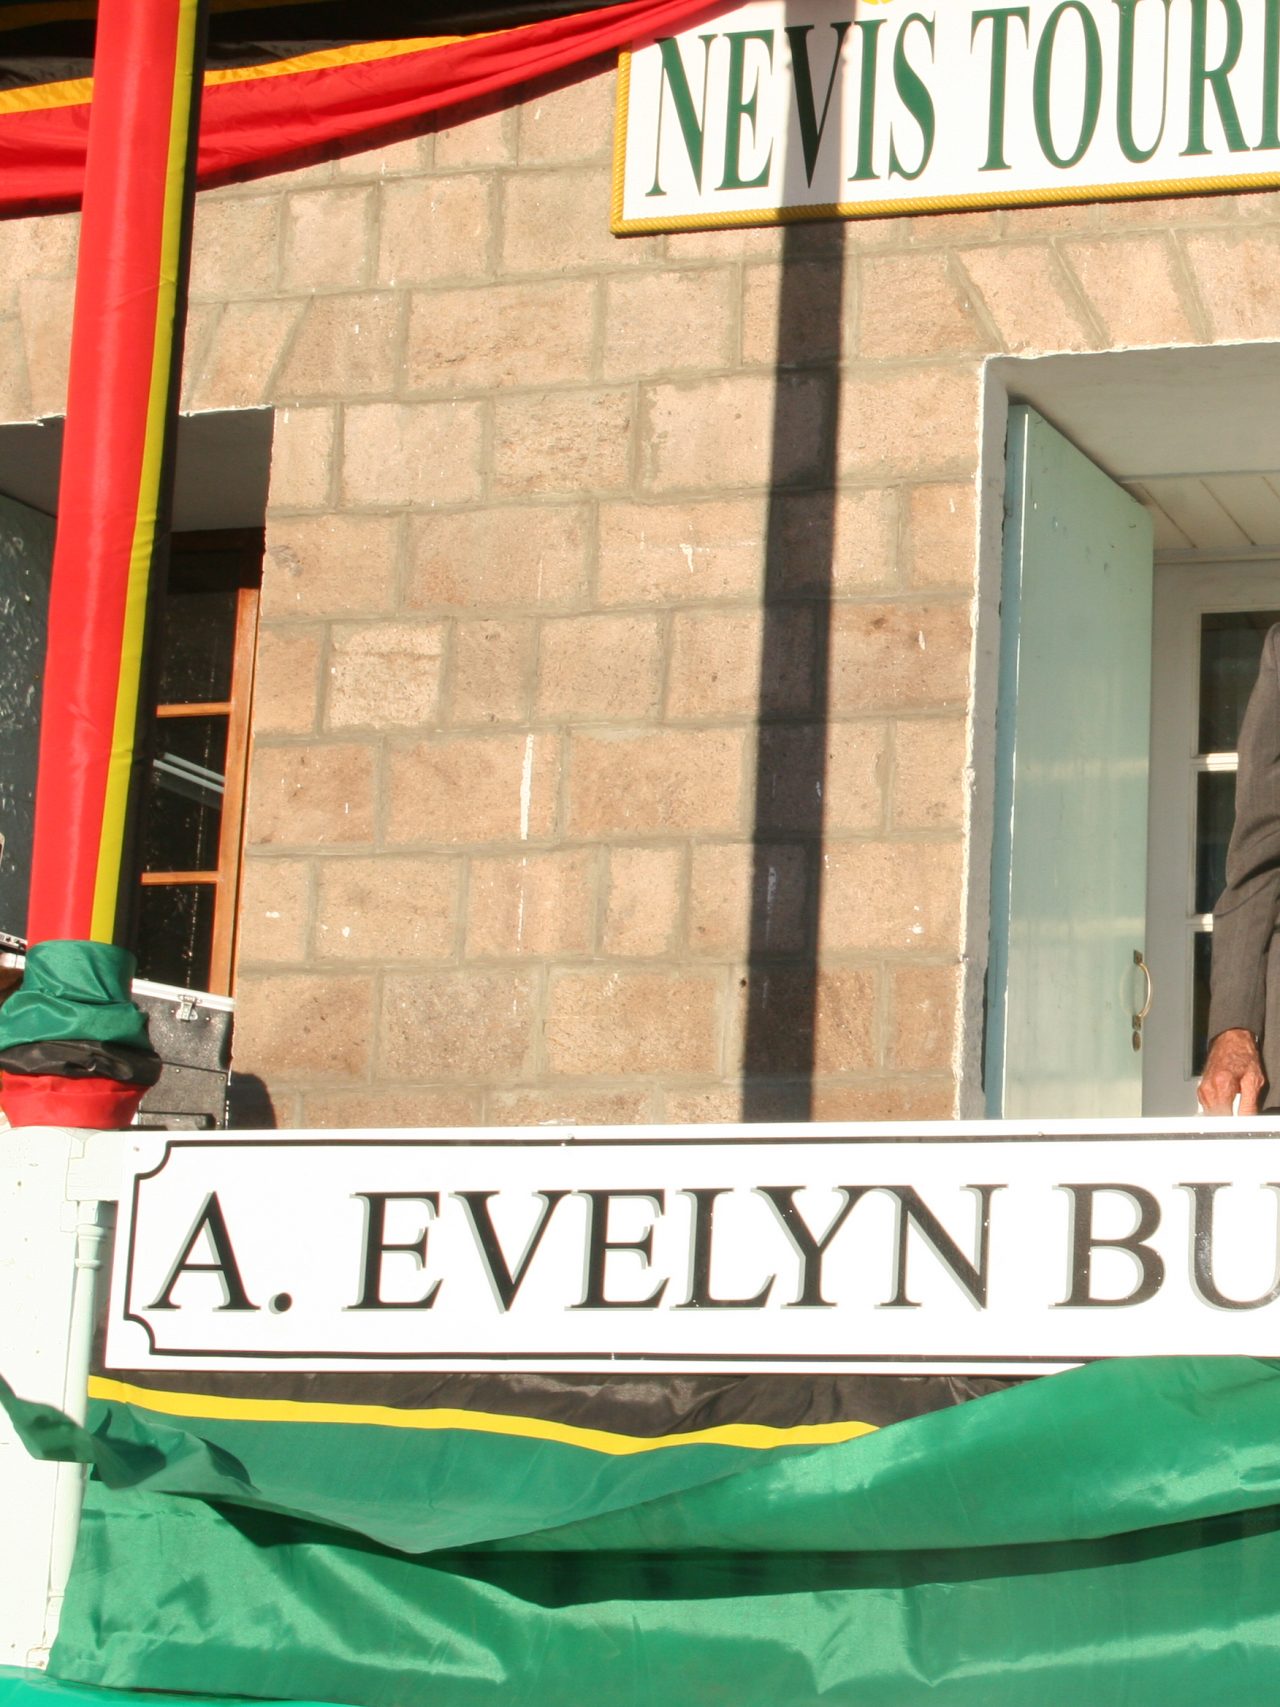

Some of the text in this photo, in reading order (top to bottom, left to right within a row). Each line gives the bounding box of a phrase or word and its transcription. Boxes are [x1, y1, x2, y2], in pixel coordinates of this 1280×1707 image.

[645, 10, 937, 198] NEVIS
[142, 1190, 293, 1315] A.
[341, 1182, 1009, 1313] EVELYN
